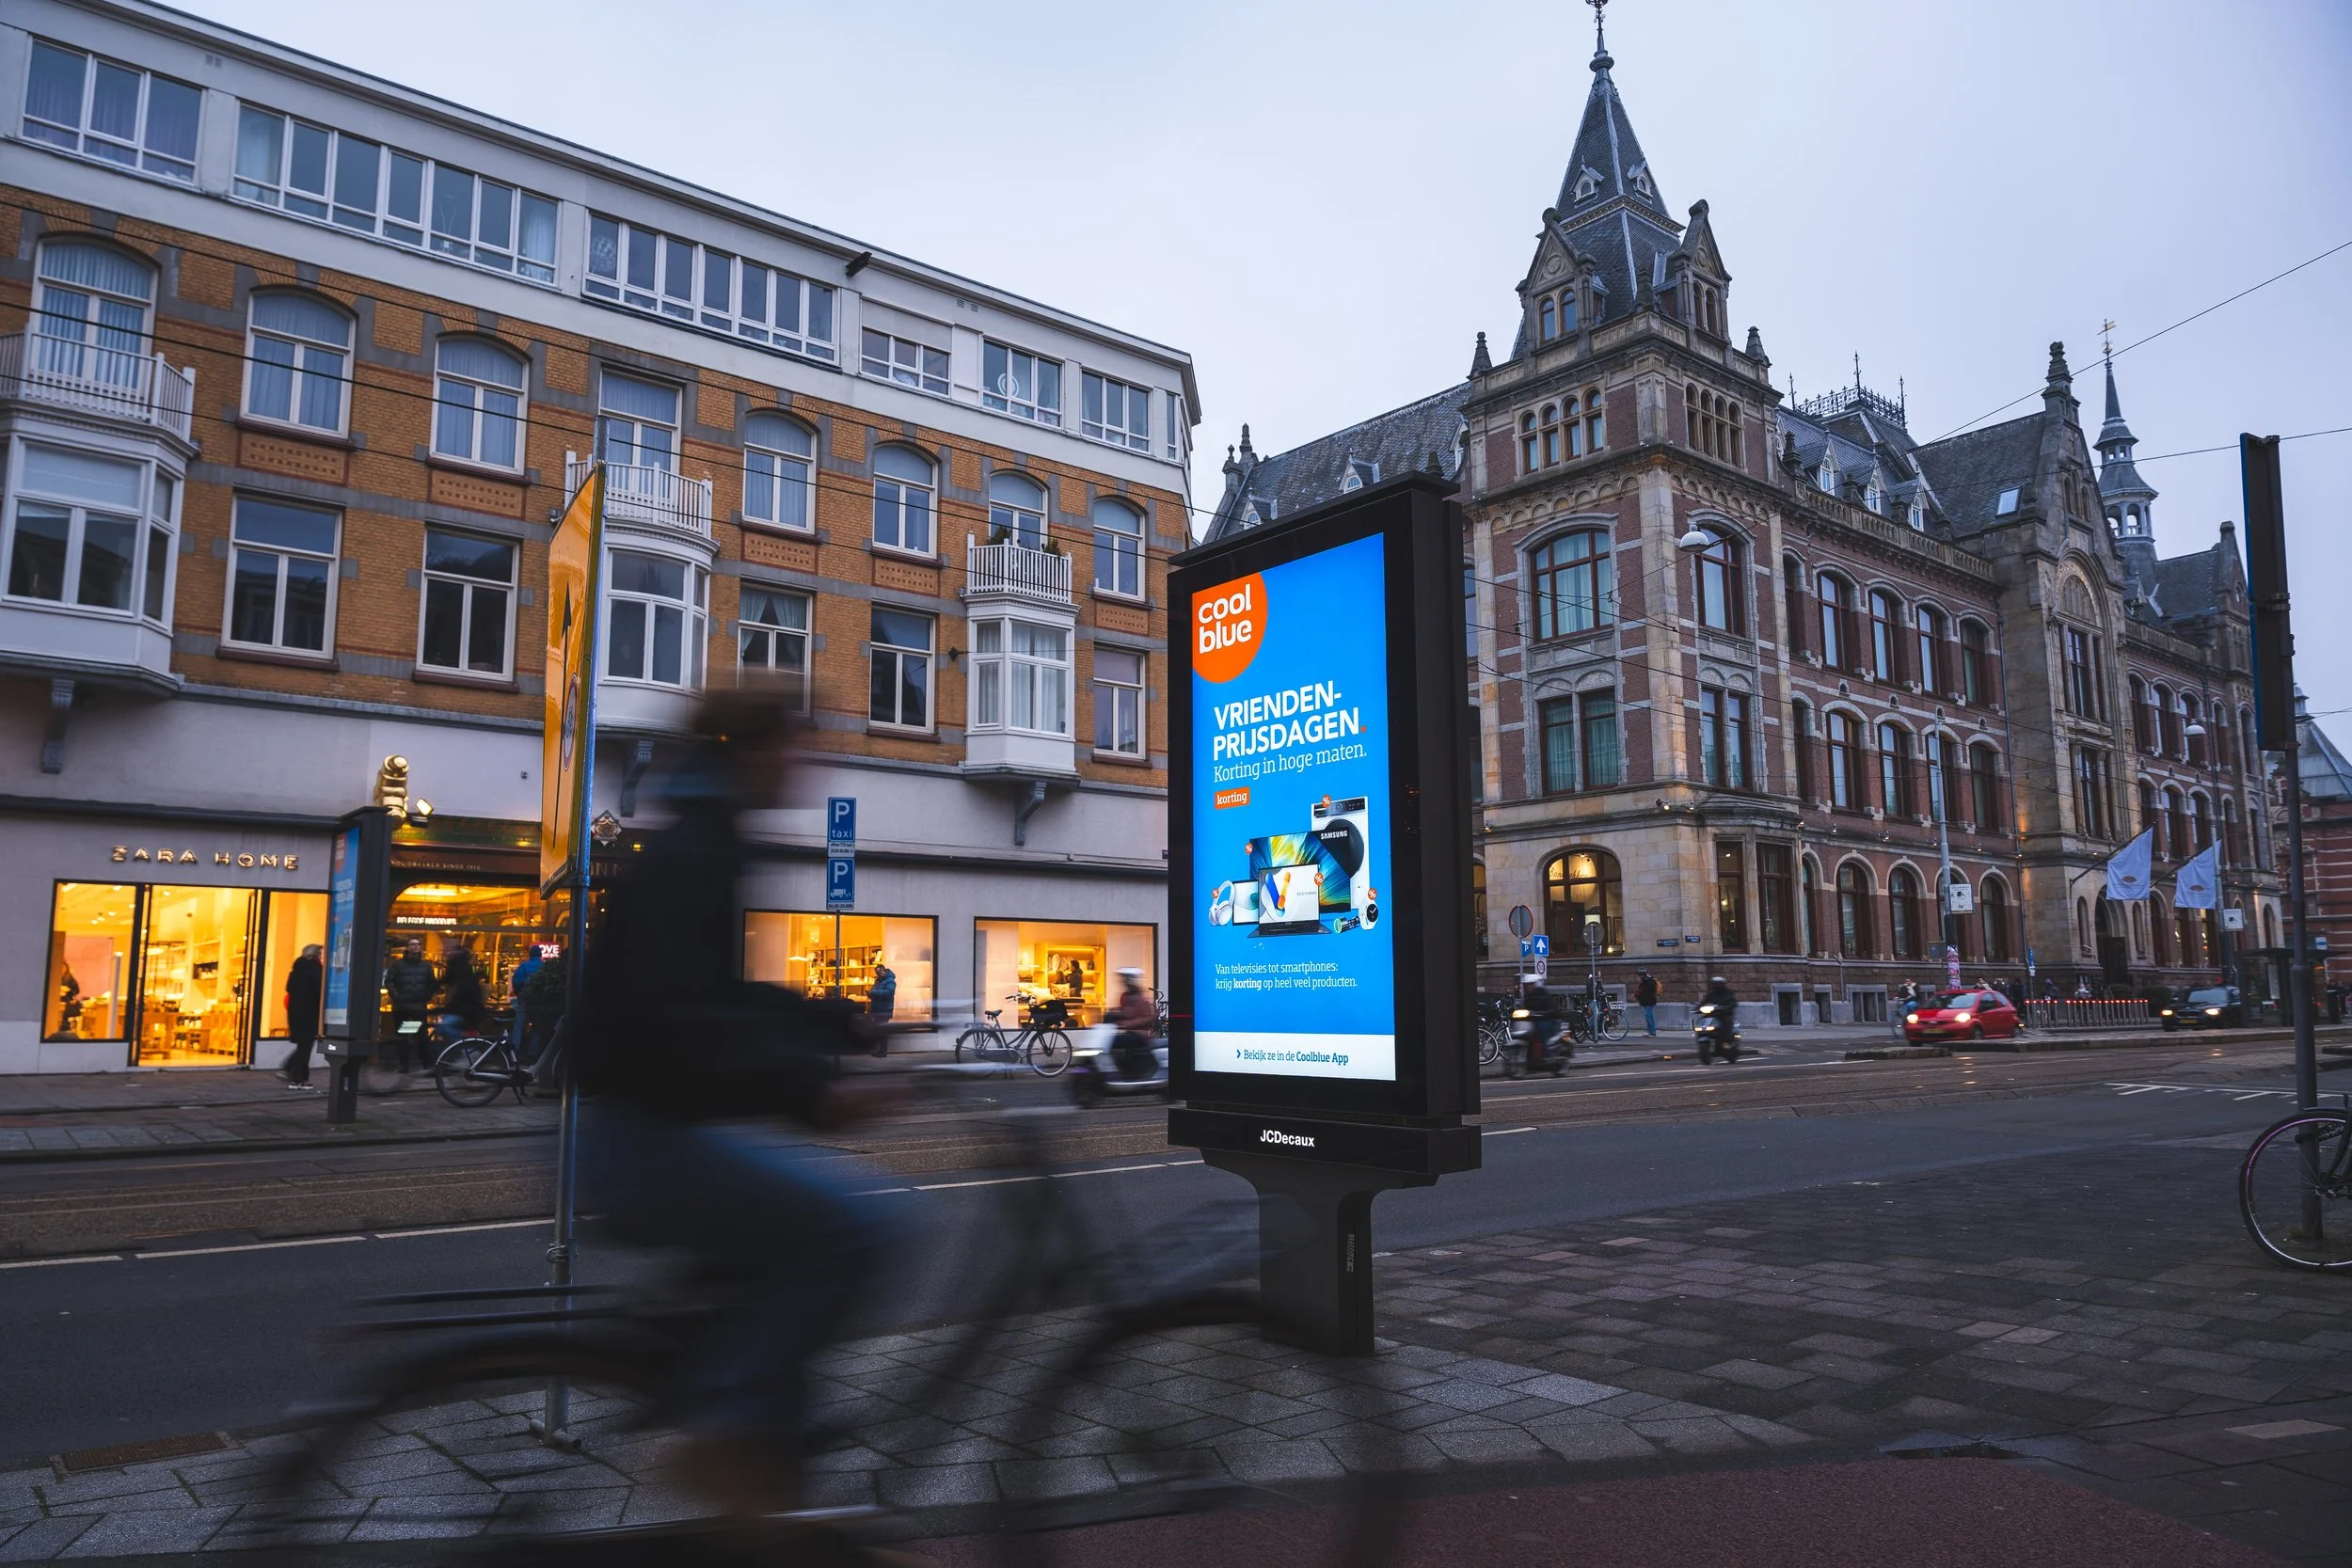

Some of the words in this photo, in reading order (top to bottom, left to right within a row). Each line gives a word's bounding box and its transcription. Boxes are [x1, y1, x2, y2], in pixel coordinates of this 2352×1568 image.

[1199, 583, 1251, 624] cool
[1199, 619, 1252, 655] blue
[1214, 680, 1342, 730] VRIENDEN-
[1214, 707, 1366, 761] PRIJSDAGEN.
[1214, 762, 1260, 783] Korting
[1263, 756, 1277, 774] in
[1279, 752, 1313, 773] hoge
[1316, 743, 1367, 765] maten.
[1216, 792, 1248, 806] korting
[835, 801, 850, 823] P
[832, 829, 852, 838] taxi
[1320, 830, 1348, 840] SAMSUNG
[112, 846, 198, 863] ZARA
[215, 852, 299, 870] HOME
[834, 862, 849, 883] P
[539, 944, 560, 954] OVE
[1216, 964, 1230, 974] Van
[1231, 963, 1266, 974] televisies
[1268, 963, 1279, 974] tot
[1280, 961, 1338, 974] smartphones:
[1216, 978, 1232, 991] krijg
[1233, 978, 1262, 990] korting
[1263, 979, 1273, 990] op
[1275, 977, 1292, 988] heel
[1294, 977, 1311, 988] veel
[1311, 976, 1358, 990] producten.
[1244, 1049, 1266, 1062] Bekijk
[1267, 1052, 1276, 1060] ze
[1277, 1050, 1284, 1061] in
[1286, 1051, 1295, 1061] de
[1296, 1051, 1329, 1063] Coolblue
[1331, 1053, 1349, 1066] App
[1260, 1129, 1315, 1148] JCDecaux
